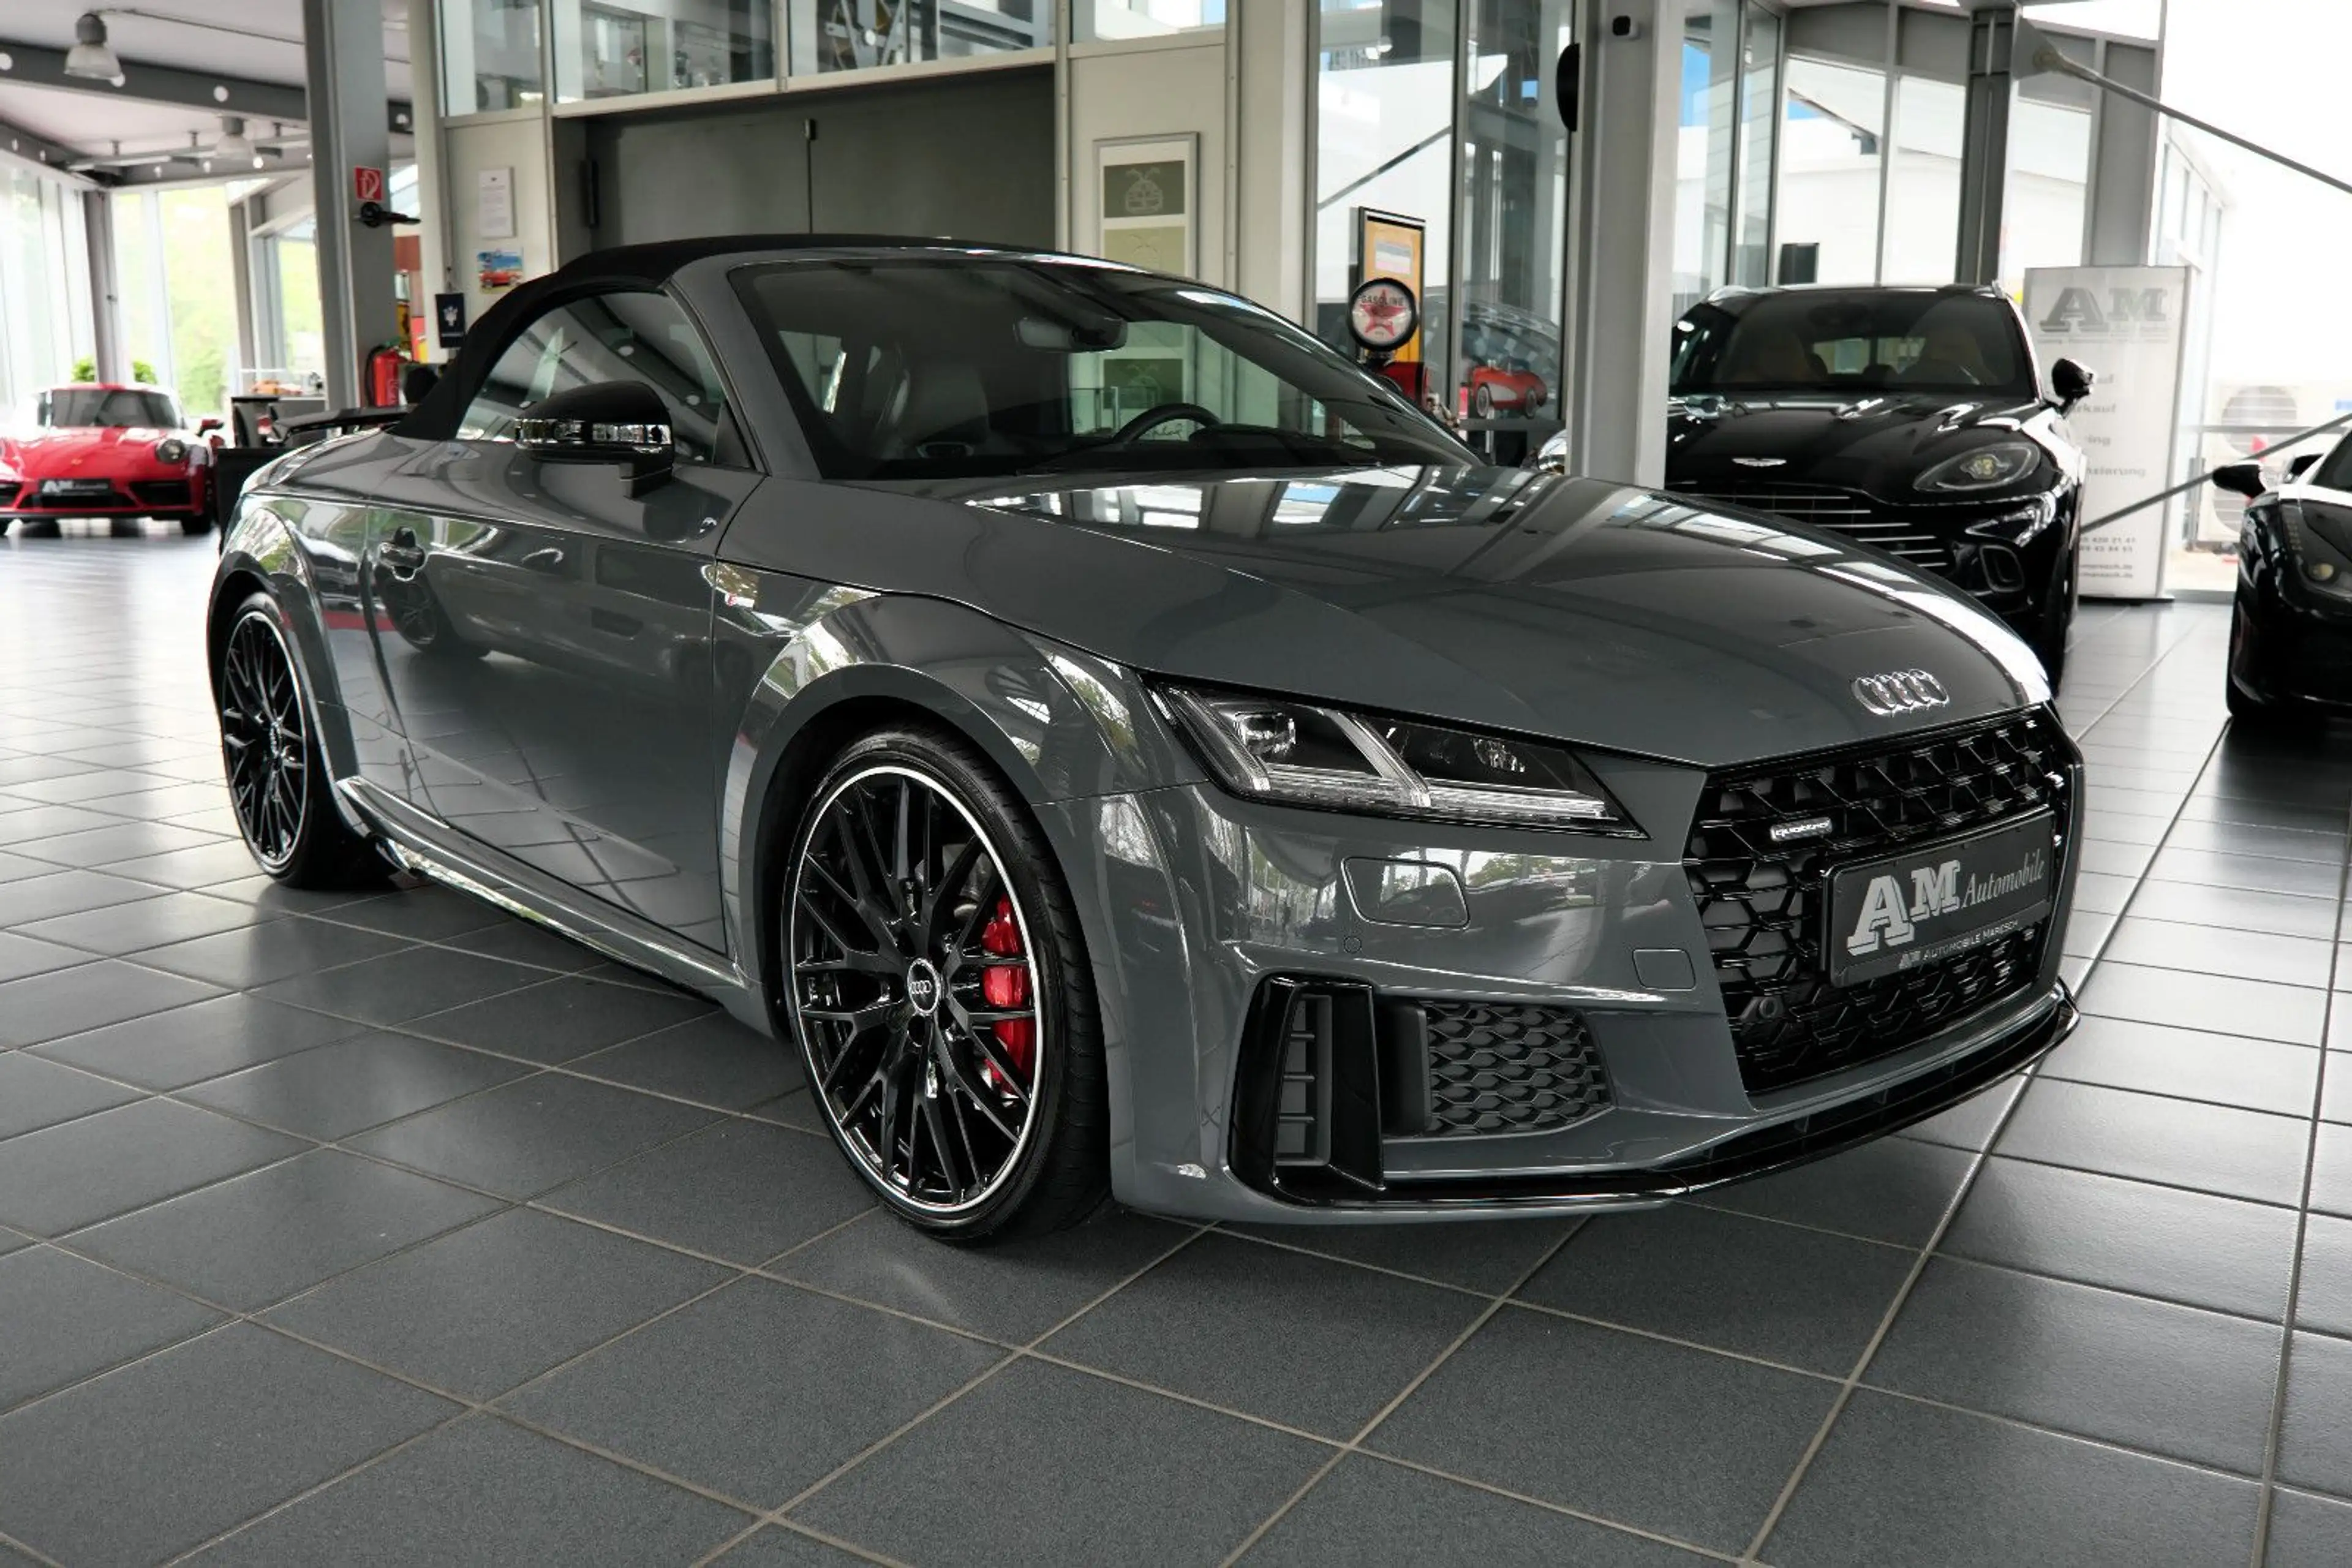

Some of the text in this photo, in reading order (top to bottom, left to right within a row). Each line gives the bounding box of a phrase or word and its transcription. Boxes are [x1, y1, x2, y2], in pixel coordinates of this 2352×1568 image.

[1361, 295, 1404, 306] GASOLINE
[2038, 287, 2168, 333] AM
[1847, 848, 2045, 957] AM Automobile
